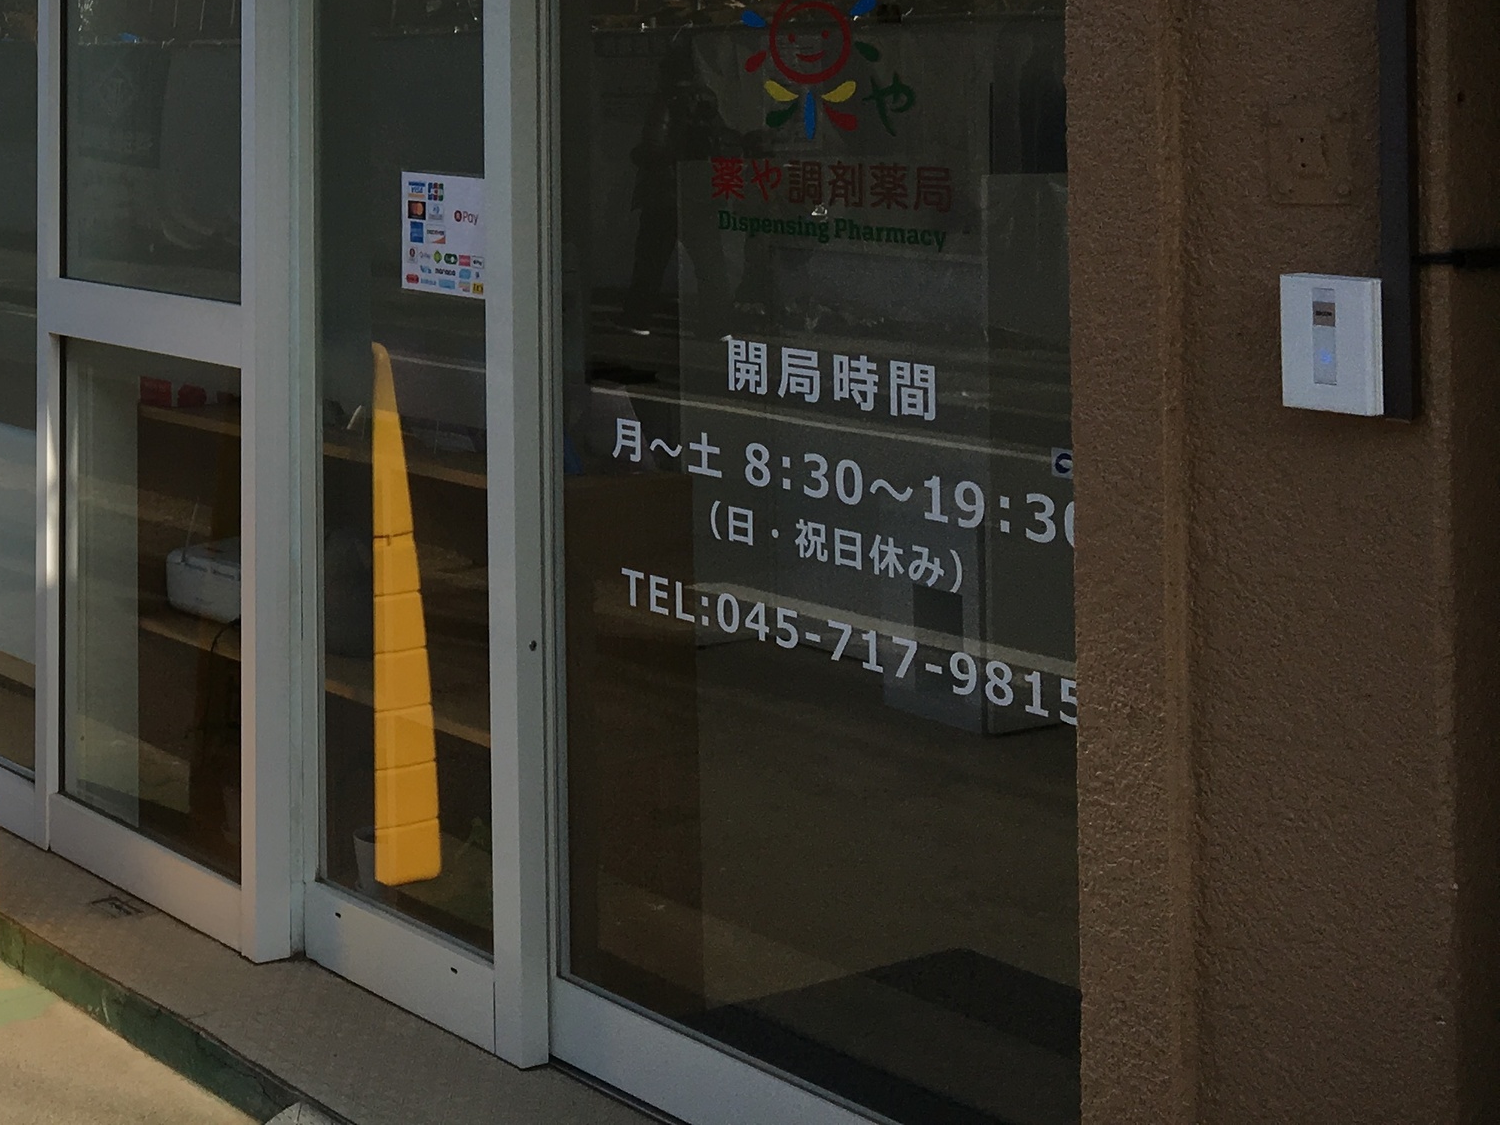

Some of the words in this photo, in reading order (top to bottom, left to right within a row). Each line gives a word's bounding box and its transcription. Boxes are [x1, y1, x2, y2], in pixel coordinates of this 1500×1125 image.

[709, 156, 954, 214] 薬や調剤薬局
[463, 211, 479, 225] Pay
[717, 209, 830, 244] Dispensing
[834, 217, 948, 252] Pharmacy
[726, 339, 937, 421] 開局時間
